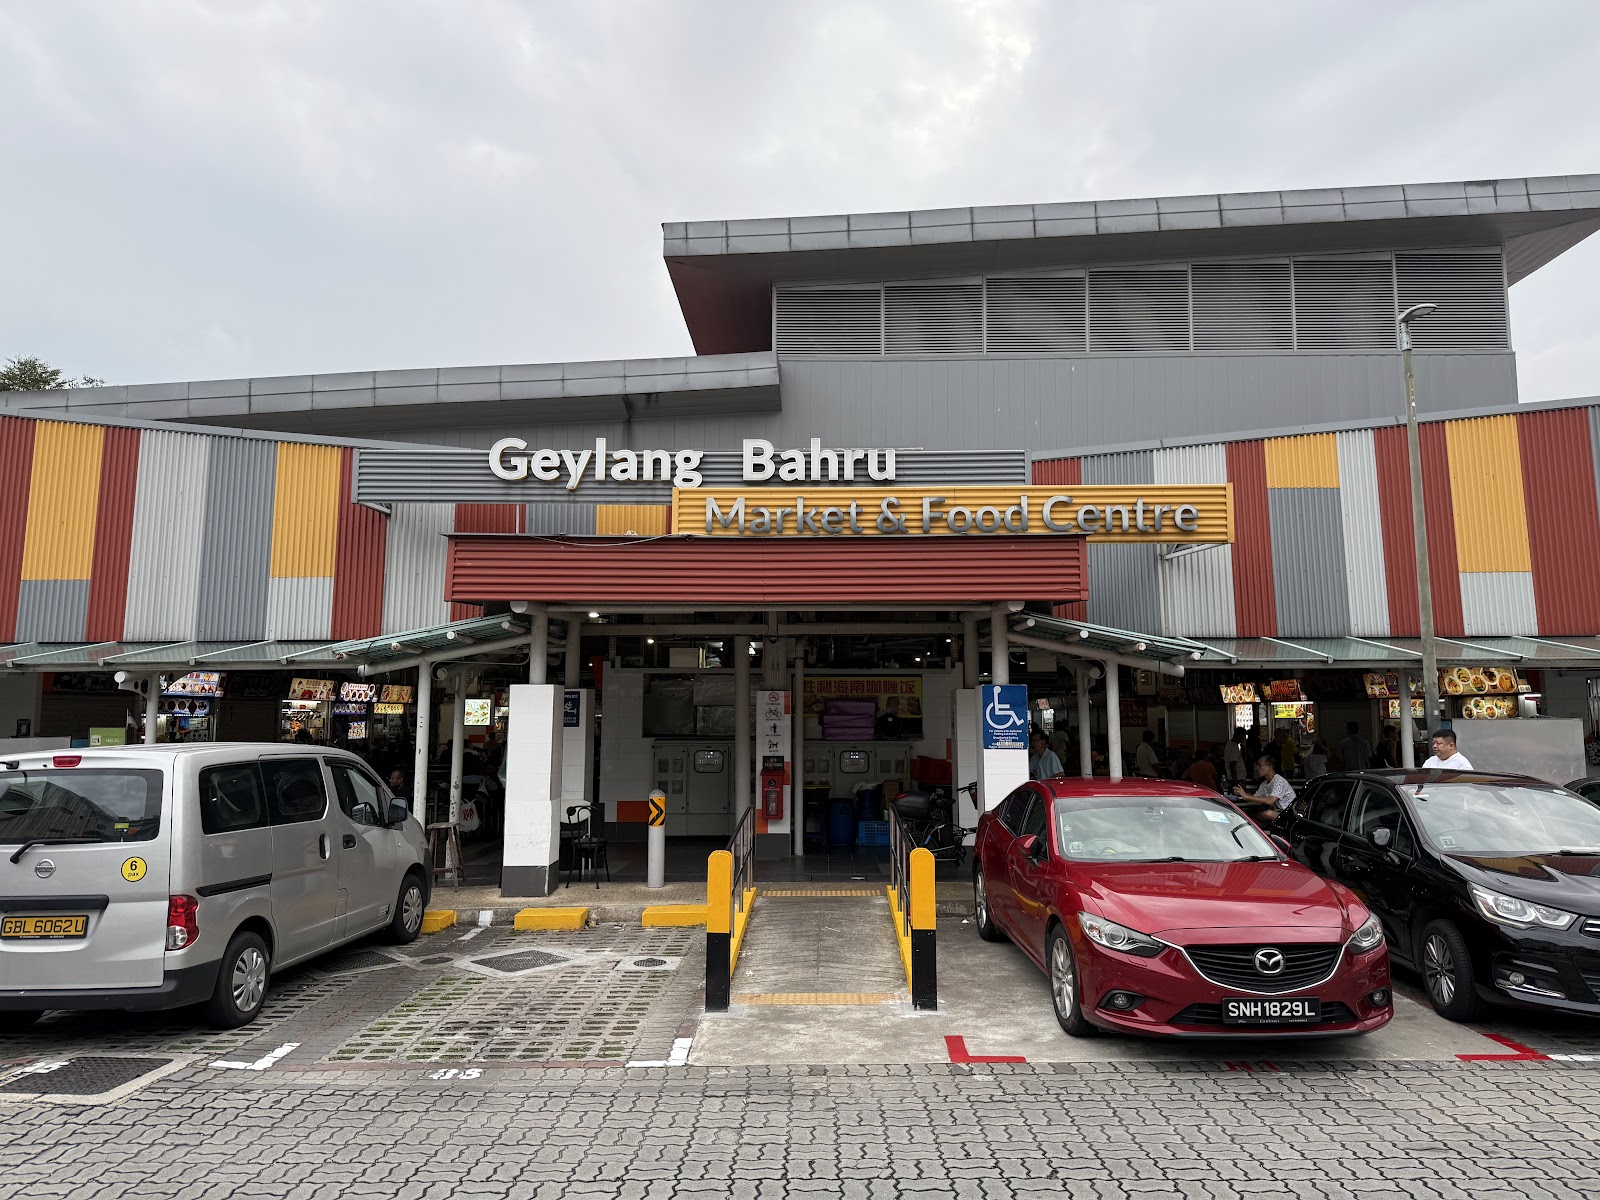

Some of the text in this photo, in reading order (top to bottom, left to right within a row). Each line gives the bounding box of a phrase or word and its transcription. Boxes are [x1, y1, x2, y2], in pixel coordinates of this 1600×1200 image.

[488, 437, 897, 491] Geylang Bahru
[704, 495, 1199, 534] Market & Food Centre
[130, 860, 138, 871] 6
[1228, 1001, 1316, 1016] SNH1829L
